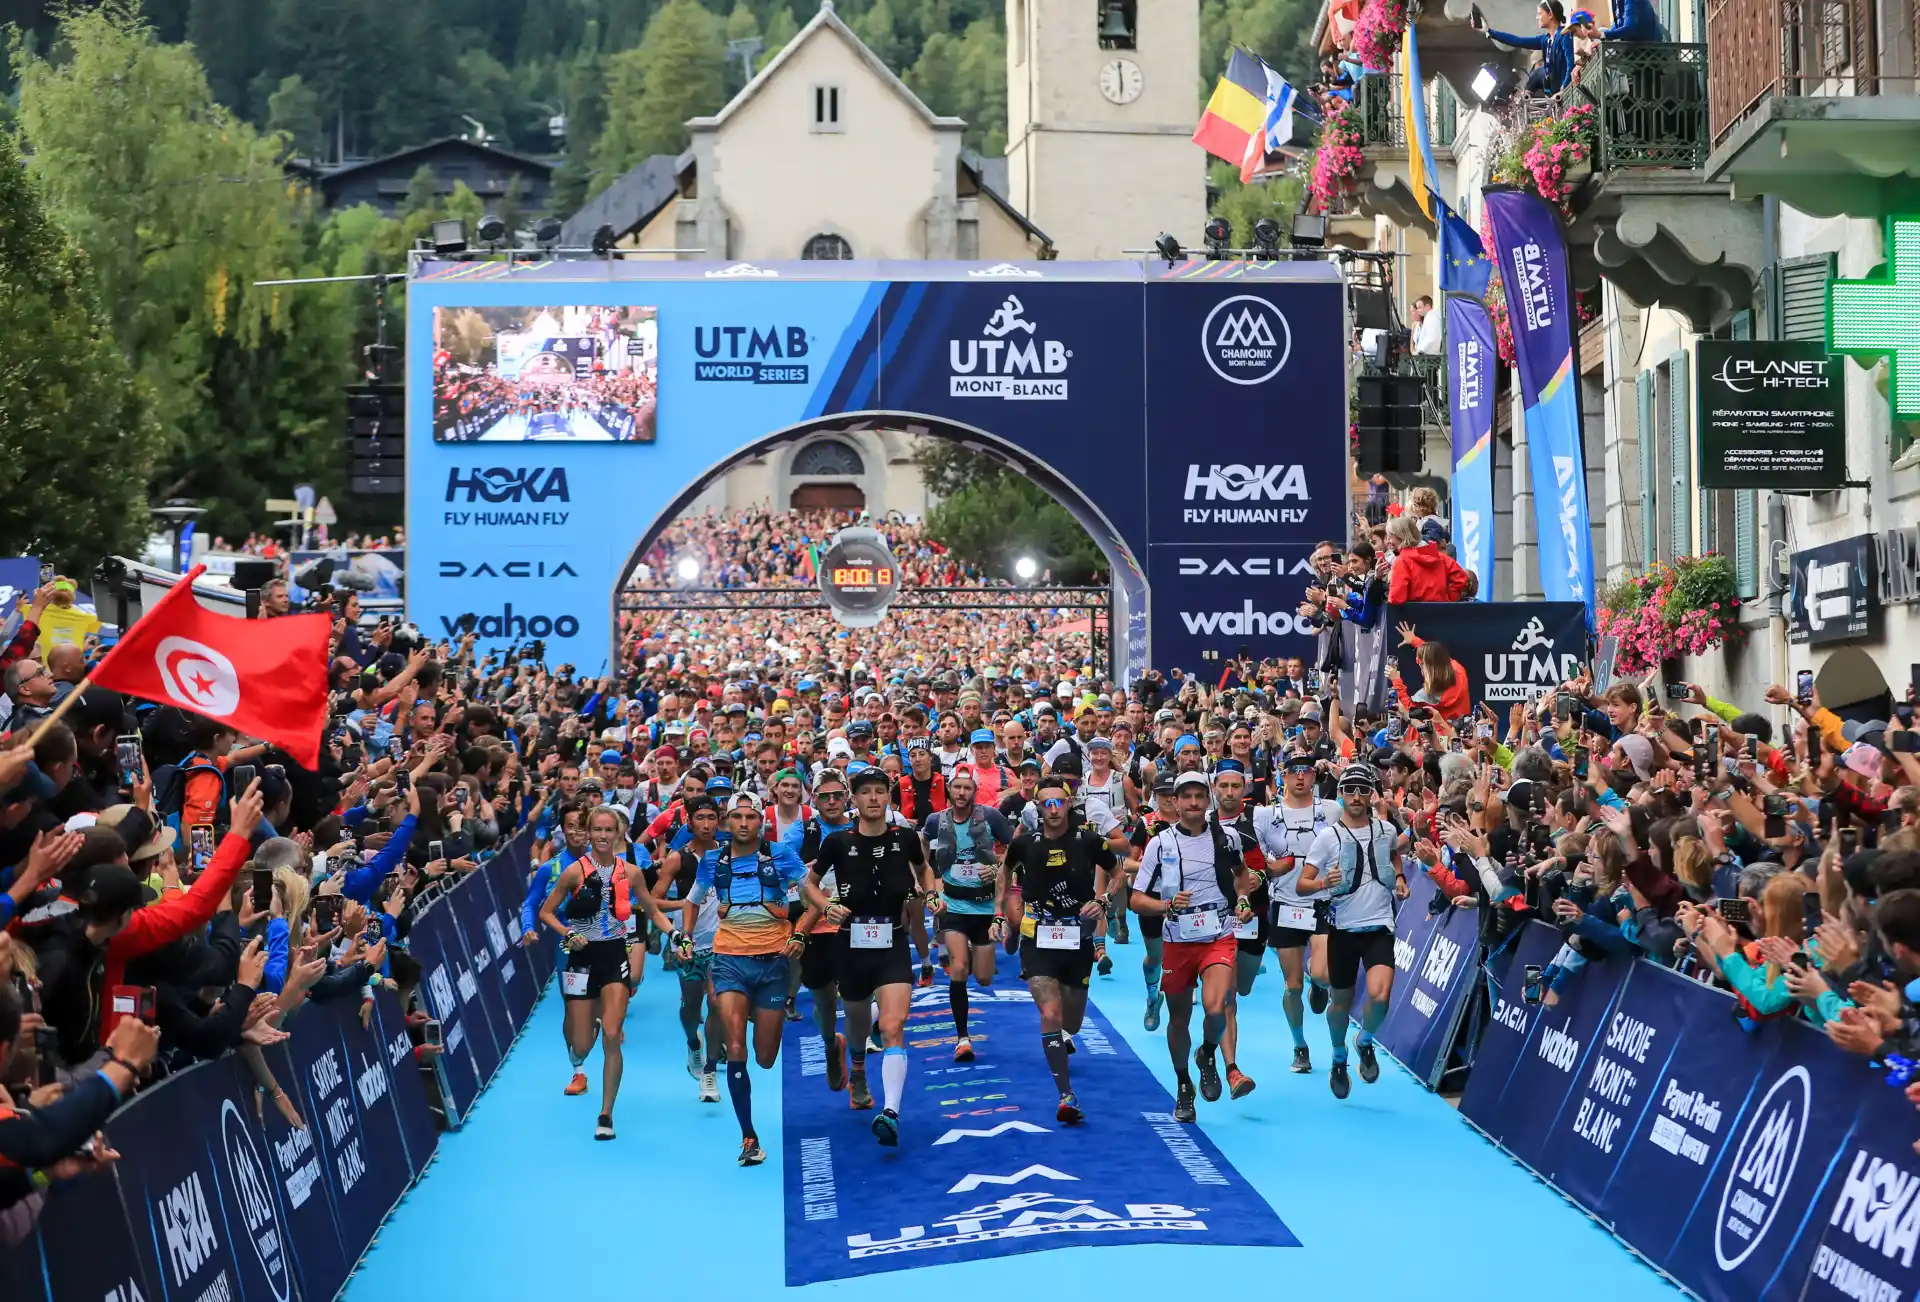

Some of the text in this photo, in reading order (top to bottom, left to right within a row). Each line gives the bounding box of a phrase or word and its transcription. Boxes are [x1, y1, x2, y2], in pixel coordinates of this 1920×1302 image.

[695, 324, 809, 359] UTMB
[950, 338, 1068, 375] UTMB
[1221, 349, 1272, 359] CHAMONIX
[700, 366, 805, 380] WORLD SERIES
[1736, 360, 1828, 374] PLANET
[1763, 378, 1829, 387] HI-TECH
[1712, 409, 1768, 417] RÉPARATION
[445, 467, 570, 502] HOKA
[1184, 464, 1309, 501] HOKA
[444, 512, 569, 525] FLY HUMAN FLY
[1184, 509, 1308, 523] FLY HUMAN FLY
[439, 562, 579, 578] DACIA
[1179, 558, 1316, 575] DACIA
[440, 603, 579, 638] wahoo
[1421, 933, 1461, 992] HOKA
[1493, 999, 1528, 1034] DACIA
[389, 1031, 413, 1067] DACIA
[1538, 1017, 1579, 1073] wahoo
[1606, 1012, 1656, 1064] SAVOIE
[312, 1048, 343, 1100] SAVOIE
[357, 1052, 387, 1110] wahoo
[1573, 1097, 1622, 1154] BLANC
[337, 1137, 366, 1195] BLANC
[1830, 1150, 1920, 1268] HOKA
[158, 1171, 218, 1288] HOKA
